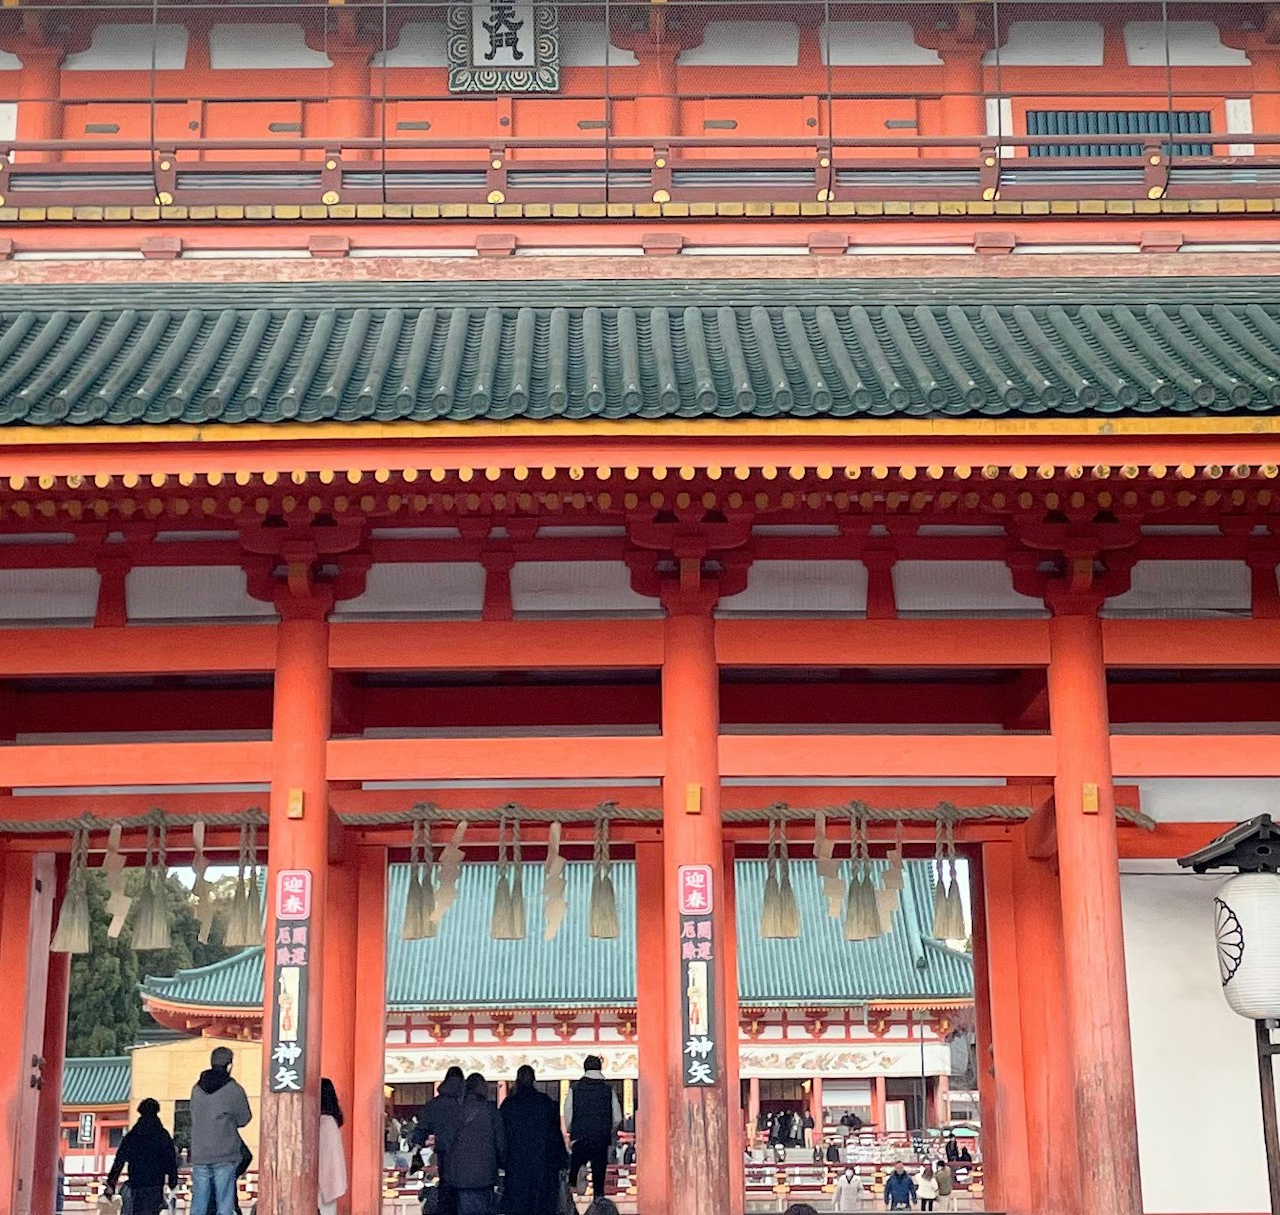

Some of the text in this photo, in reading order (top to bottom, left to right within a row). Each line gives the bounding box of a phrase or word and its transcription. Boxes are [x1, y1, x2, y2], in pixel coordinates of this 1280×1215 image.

[282, 876, 305, 914] 迎春
[684, 871, 708, 908] 迎春
[271, 1042, 302, 1090] 神矢
[684, 1036, 715, 1084] 神矢
